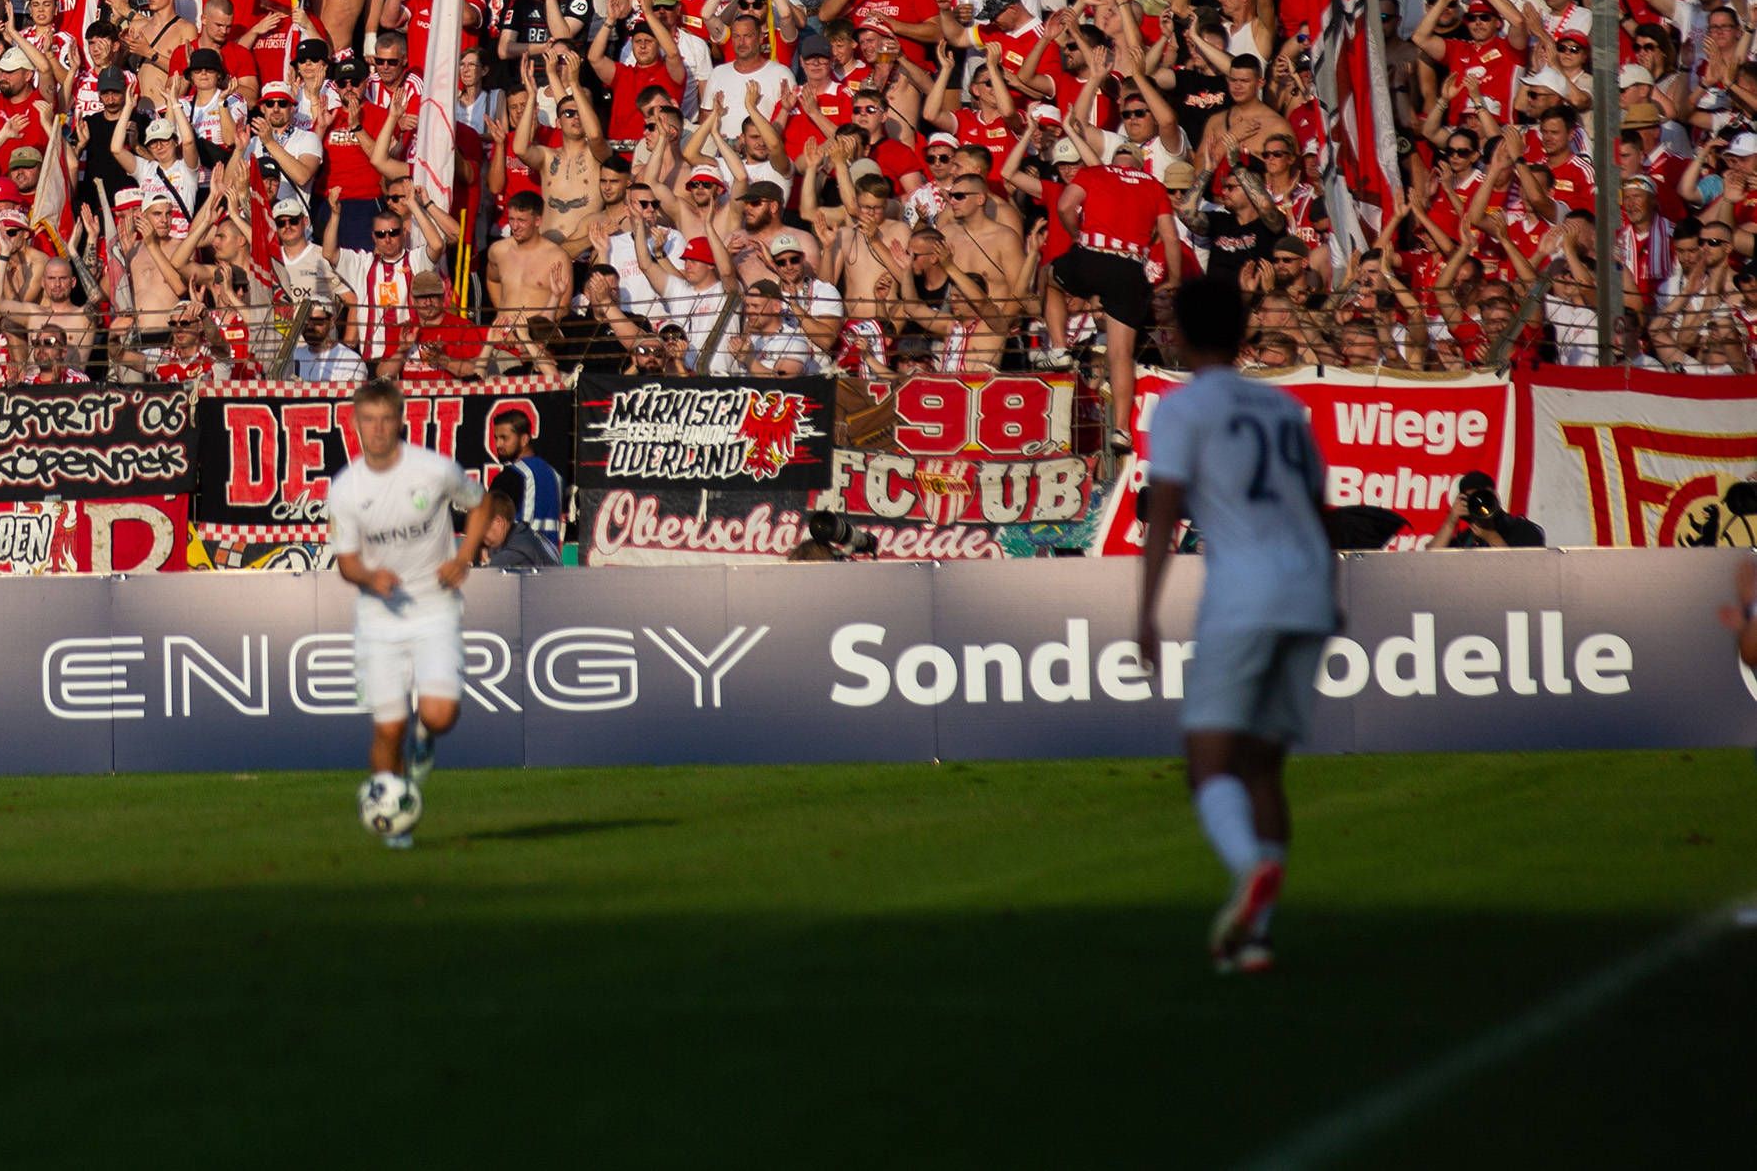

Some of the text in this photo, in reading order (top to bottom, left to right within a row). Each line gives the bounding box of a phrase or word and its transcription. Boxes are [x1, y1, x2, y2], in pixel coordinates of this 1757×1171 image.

[609, 382, 750, 430] MÄRKISCH
[1334, 401, 1489, 456] Wiege
[607, 439, 750, 479] ODERLAND
[42, 625, 770, 721] ENERGY
[830, 611, 1635, 706] Sonderodelle
